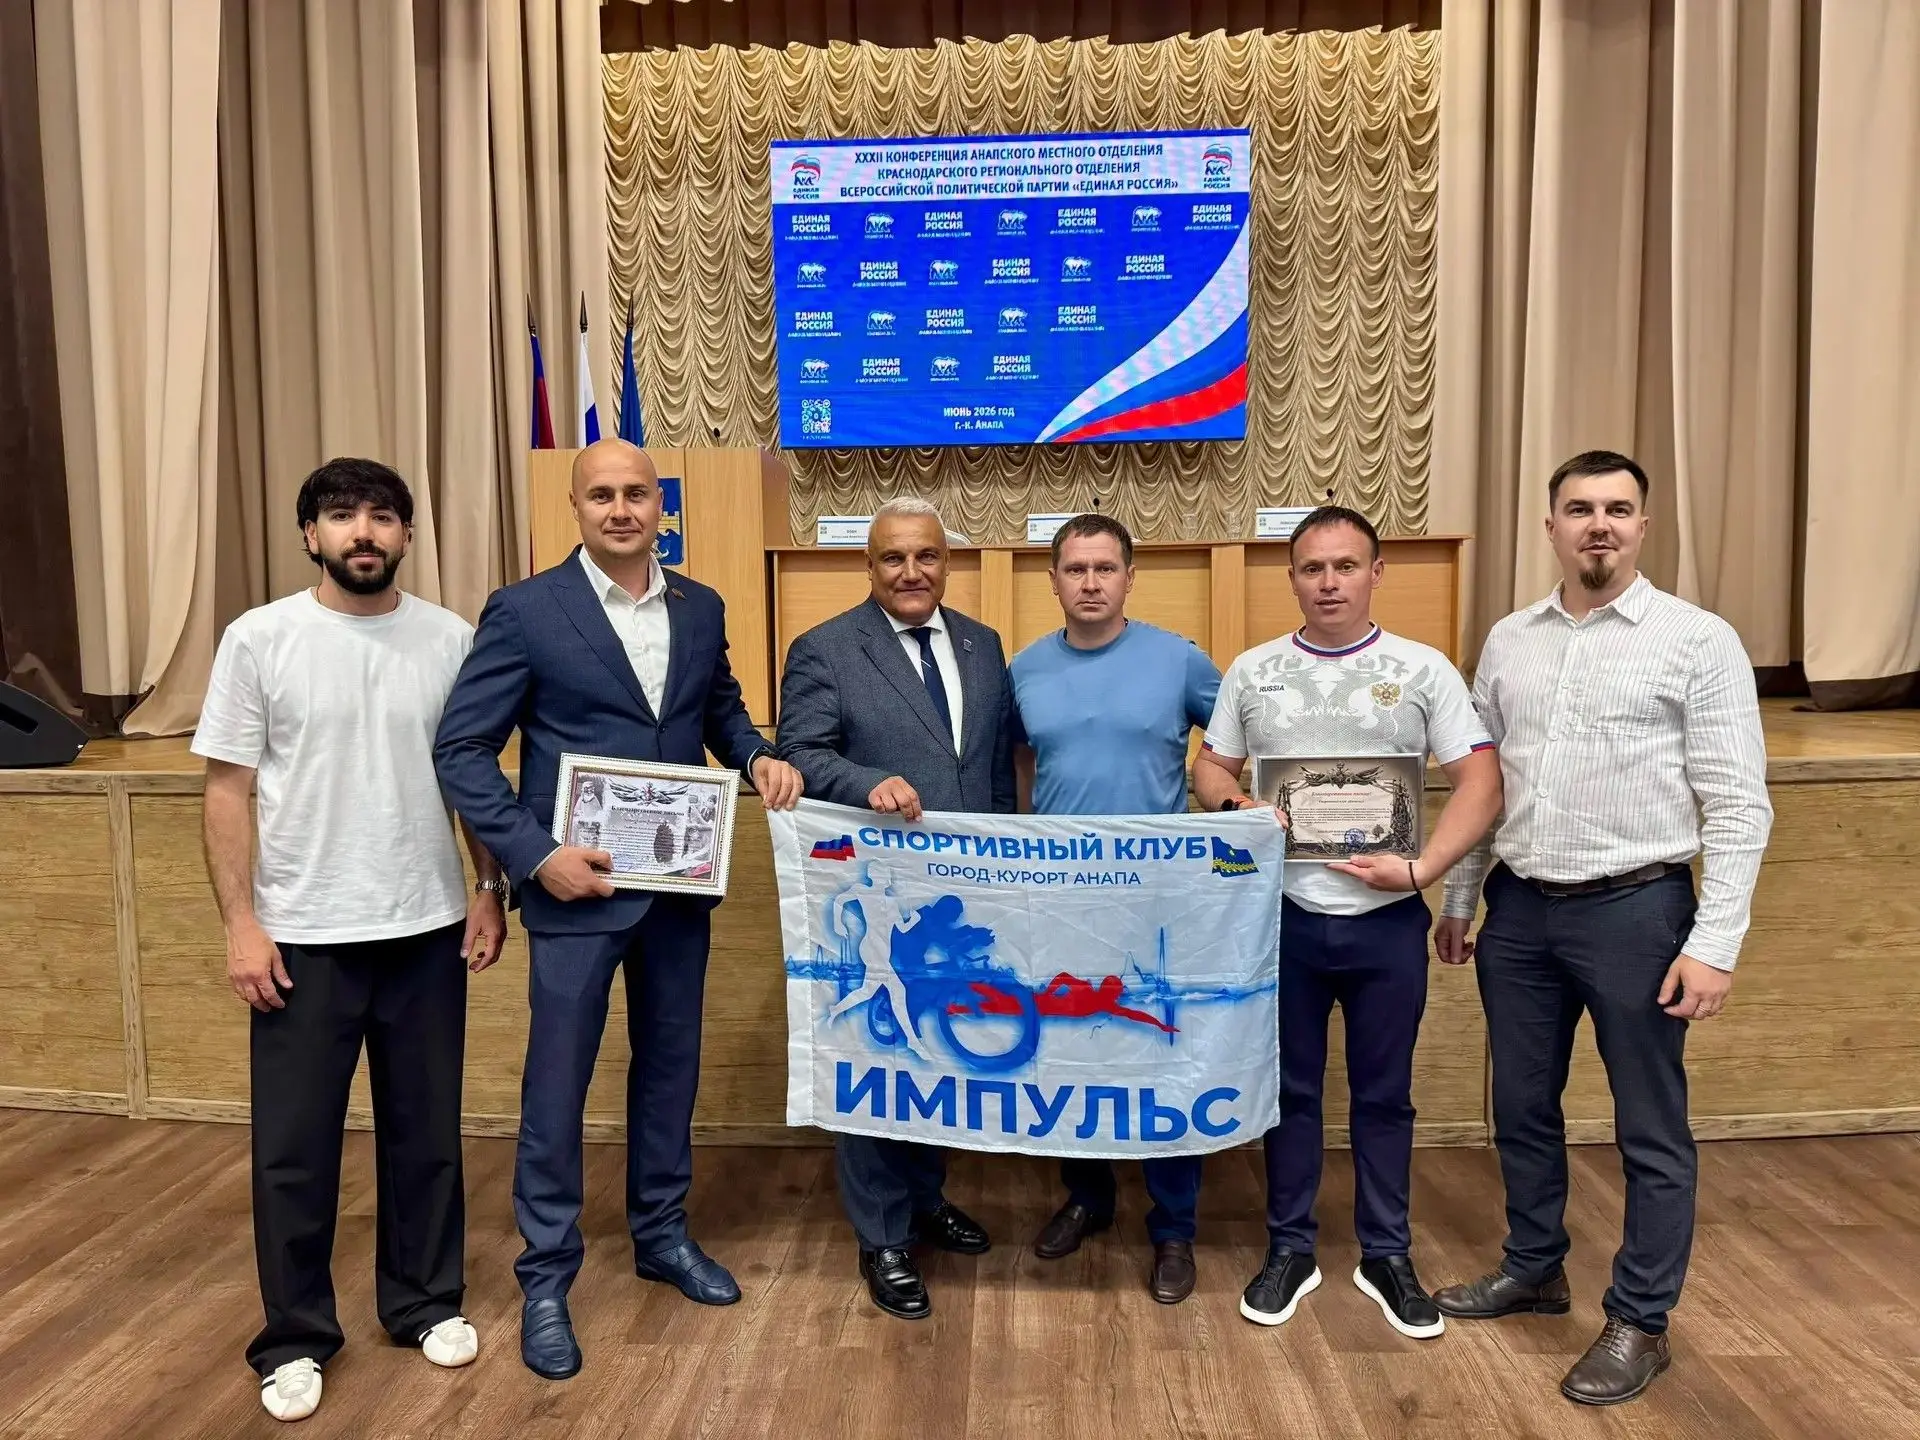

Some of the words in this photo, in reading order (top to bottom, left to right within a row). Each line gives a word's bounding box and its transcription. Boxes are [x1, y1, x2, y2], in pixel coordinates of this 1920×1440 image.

[886, 150, 967, 163] КОНФЕРЕНЦИЯ
[970, 147, 1035, 161] АНАПСКОГО
[1039, 146, 1094, 158] МЕСТНОГО
[1099, 144, 1163, 157] ОТДЕЛЕНИЯ
[878, 166, 978, 180] КРАСНОДАРСКОГО
[982, 163, 1072, 177] РЕГИОНАЛЬНОГО
[1076, 163, 1140, 175] ОТДЕЛЕНИЯ
[841, 182, 933, 197] ВСЕРОССИЙСКОЙ
[936, 179, 1023, 196] ПОЛИТИЧЕСКОЙ
[1027, 180, 1069, 193] ПАРТИИ
[1073, 181, 1124, 193] «ЕДИНАЯ
[1127, 178, 1178, 190] РОССИЯ»
[1058, 208, 1096, 217] ЕДИНАЯ
[1193, 205, 1232, 214] ЕДИНАЯ
[792, 215, 830, 224] ЕДИНАЯ
[925, 212, 962, 221] ЕДИНАЯ
[1193, 213, 1232, 223] РОССИЯ
[925, 221, 963, 230] РОССИЯ
[1058, 217, 1096, 226] РОССИЯ
[793, 224, 830, 233] РОССИЯ
[992, 259, 1030, 268] ЕДИНАЯ
[1126, 255, 1164, 264] ЕДИНАЯ
[860, 262, 898, 271] ЕДИНАЯ
[1126, 264, 1164, 273] РОССИЯ
[861, 270, 898, 280] РОССИЯ
[993, 268, 1030, 277] РОССИЯ
[926, 309, 963, 318] ЕДИНАЯ
[1058, 306, 1096, 315] ЕДИНАЯ
[795, 312, 832, 321] ЕДИНАЯ
[1059, 315, 1096, 324] РОССИЯ
[796, 321, 832, 330] РОССИЯ
[927, 318, 964, 327] РОССИЯ
[863, 358, 900, 367] ЕДИНАЯ
[993, 356, 1030, 365] ЕДИНАЯ
[863, 367, 900, 376] РОССИЯ
[994, 365, 1030, 373] РОССИЯ
[944, 408, 971, 416] ИЮНЬ
[974, 407, 996, 416] 2026
[858, 826, 1103, 860] СПОРТИВНЫЙ
[1115, 836, 1207, 860] КЛУБ
[927, 863, 1069, 885] ГОРОД-КУРОРТ
[1074, 872, 1141, 885] АНАПА
[835, 1061, 1240, 1142] ИМПУЛЬС
